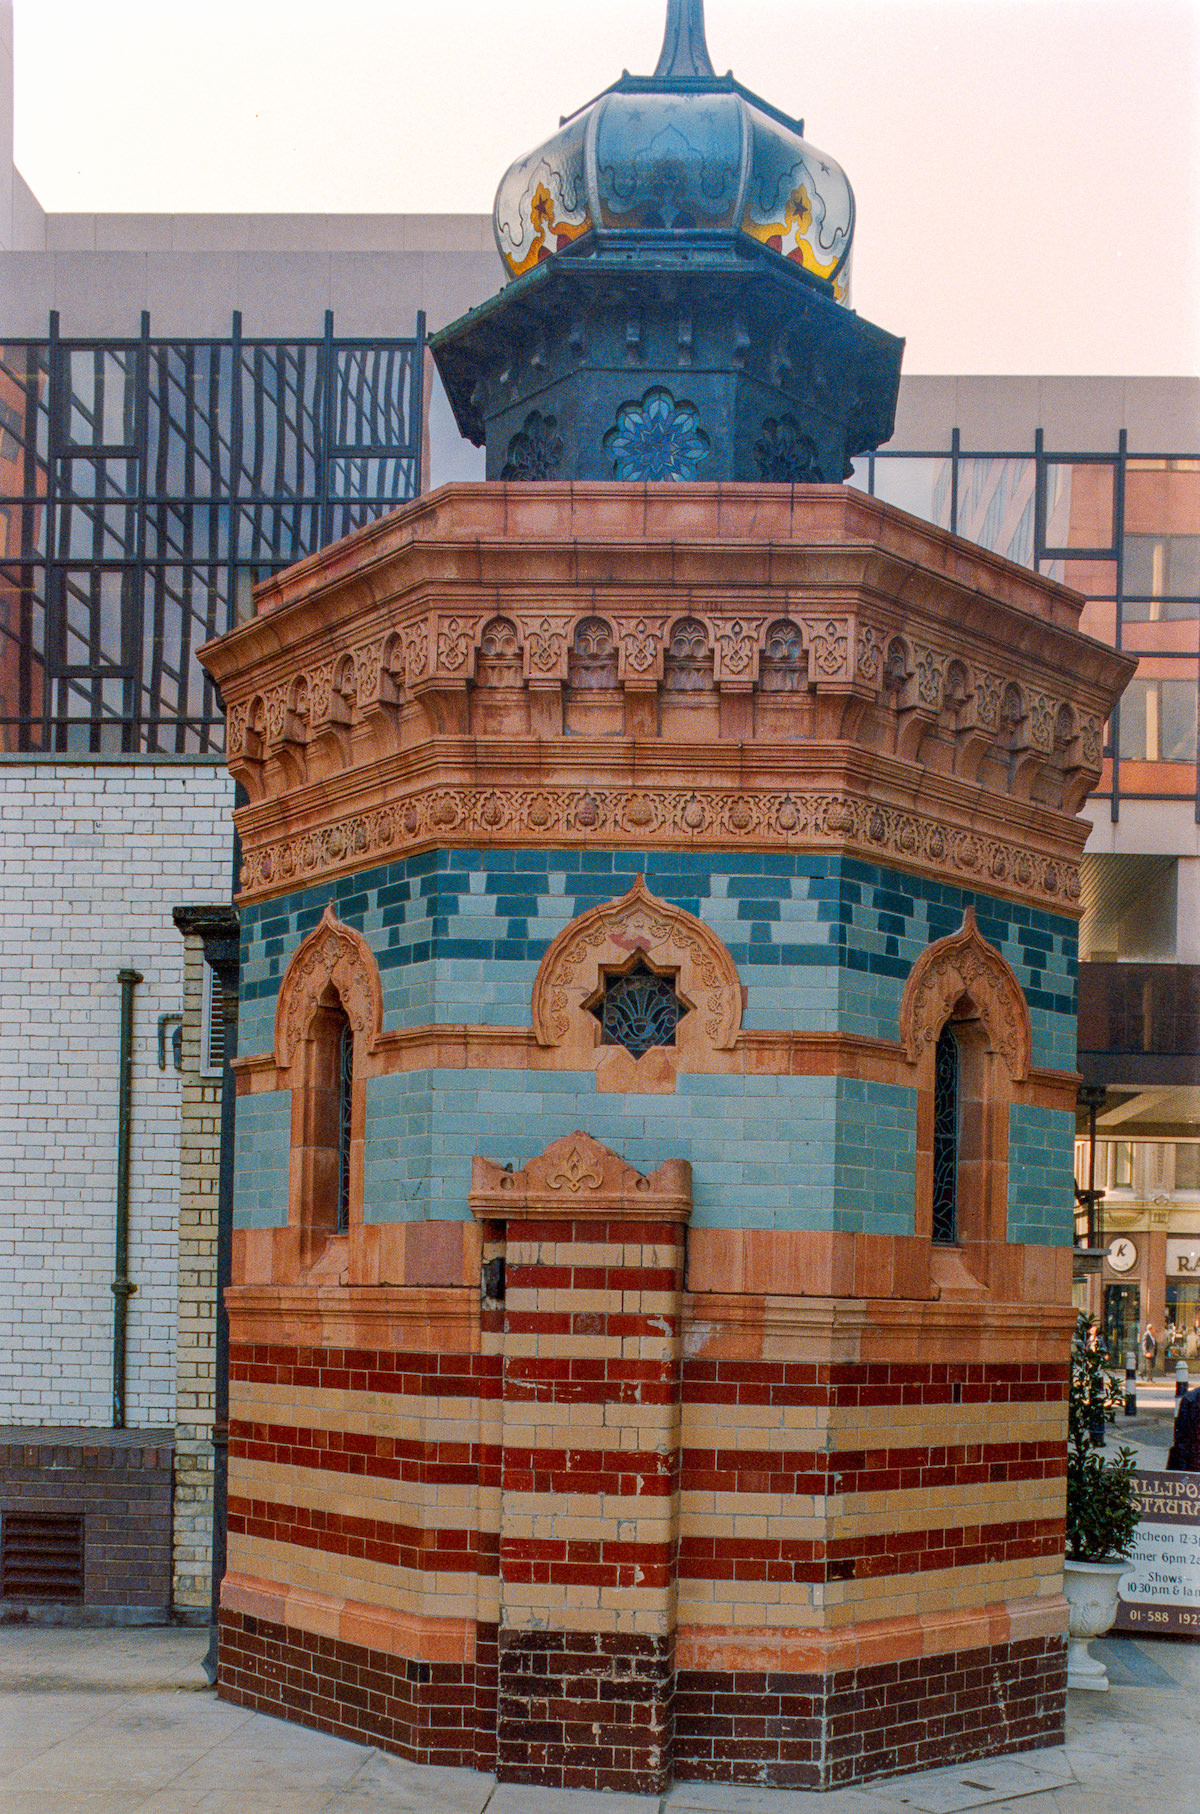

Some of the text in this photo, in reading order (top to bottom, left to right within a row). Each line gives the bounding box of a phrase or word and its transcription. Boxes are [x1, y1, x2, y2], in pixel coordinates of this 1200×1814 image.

[1117, 1244, 1127, 1257] K
[1129, 1479, 1200, 1498] ALLIPO
[1180, 1533, 1200, 1547] 12-3
[1148, 1571, 1183, 1584] Shows
[1130, 1609, 1200, 1625] 01-588 192
